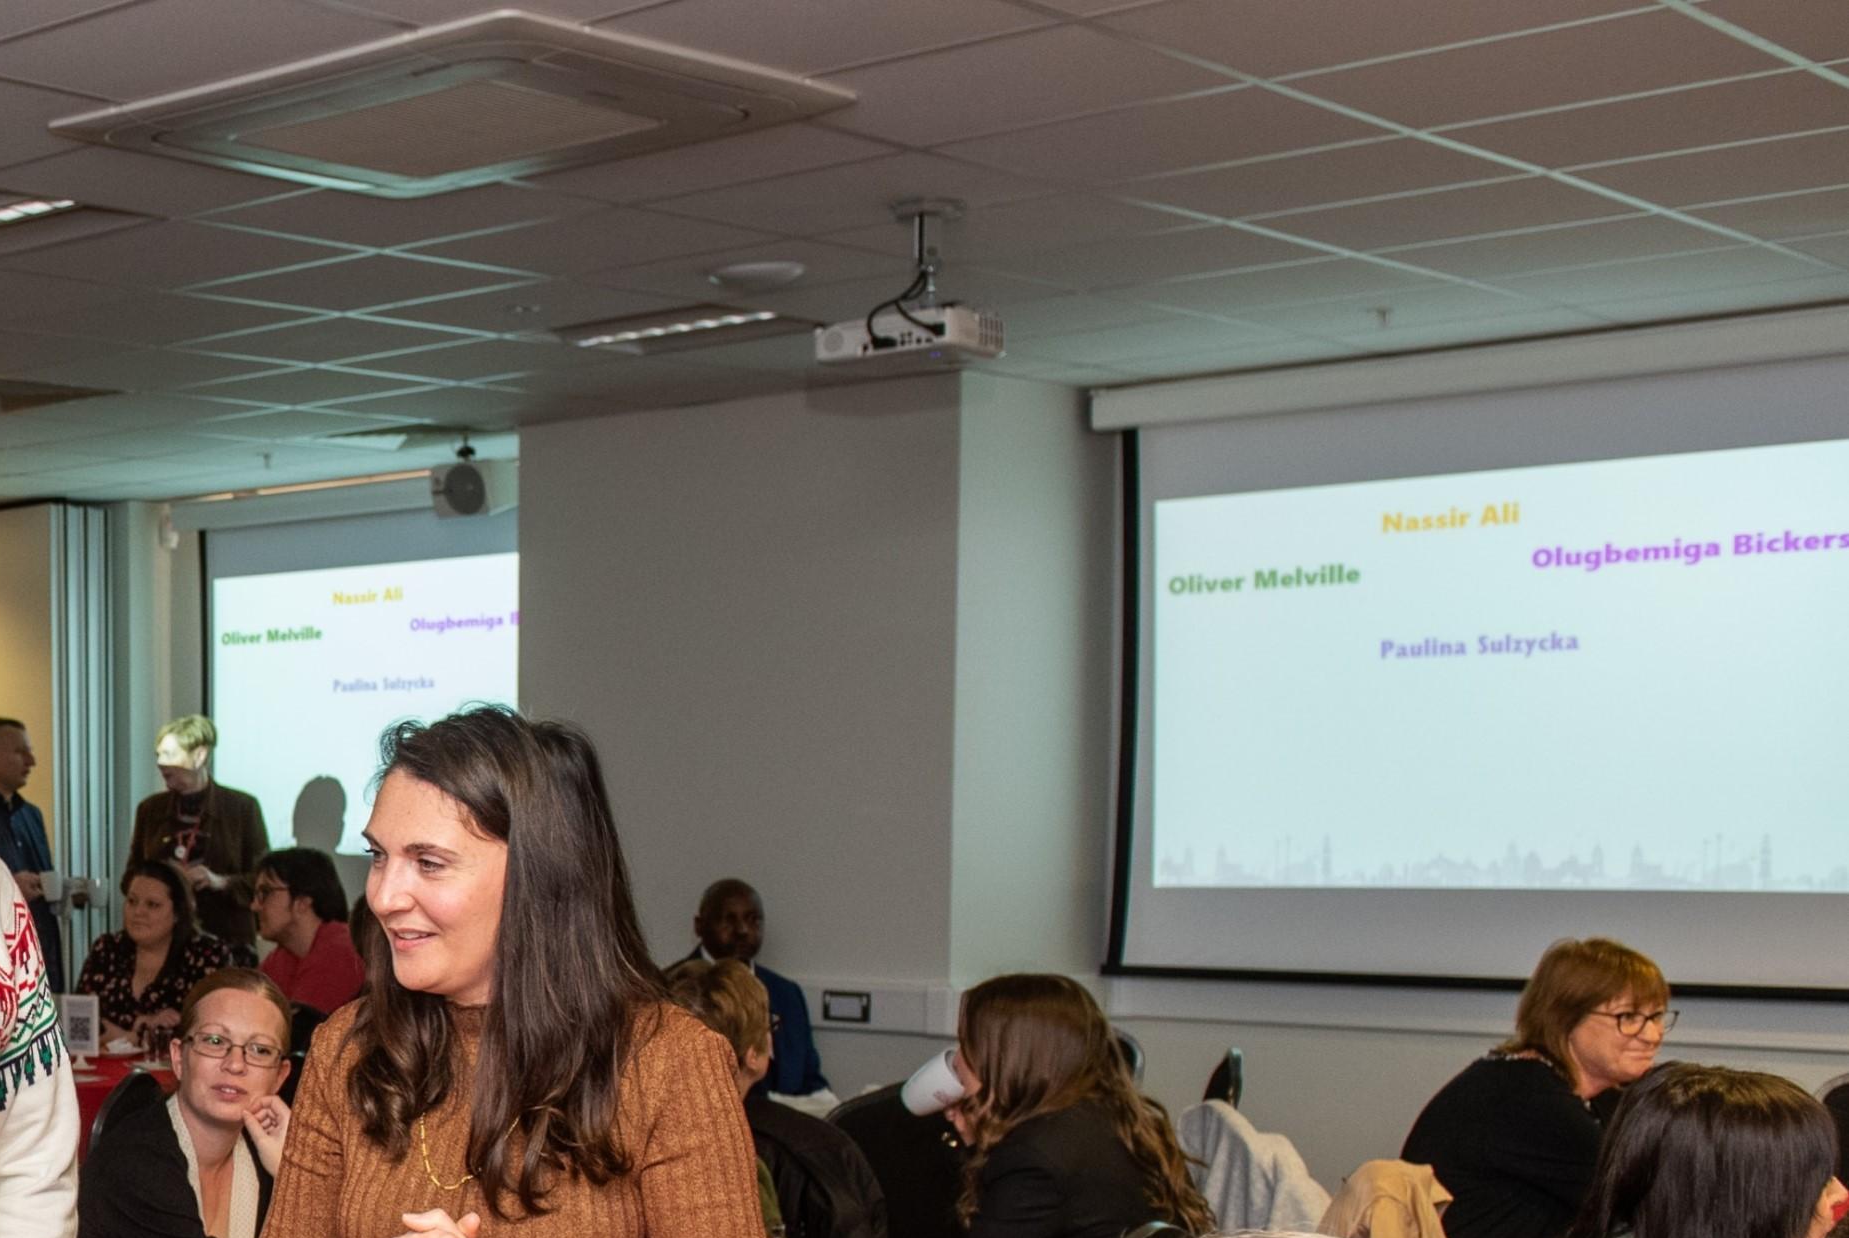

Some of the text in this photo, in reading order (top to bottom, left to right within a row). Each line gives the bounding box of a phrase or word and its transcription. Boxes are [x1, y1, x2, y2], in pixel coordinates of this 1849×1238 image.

[1381, 503, 1521, 534] Nassir Ali
[1532, 538, 1721, 572] Olugbemiga
[1168, 563, 1361, 596] Oliver Melville
[221, 626, 323, 646] Oliver Melville
[1380, 631, 1580, 660] Paulina Sulzycka
